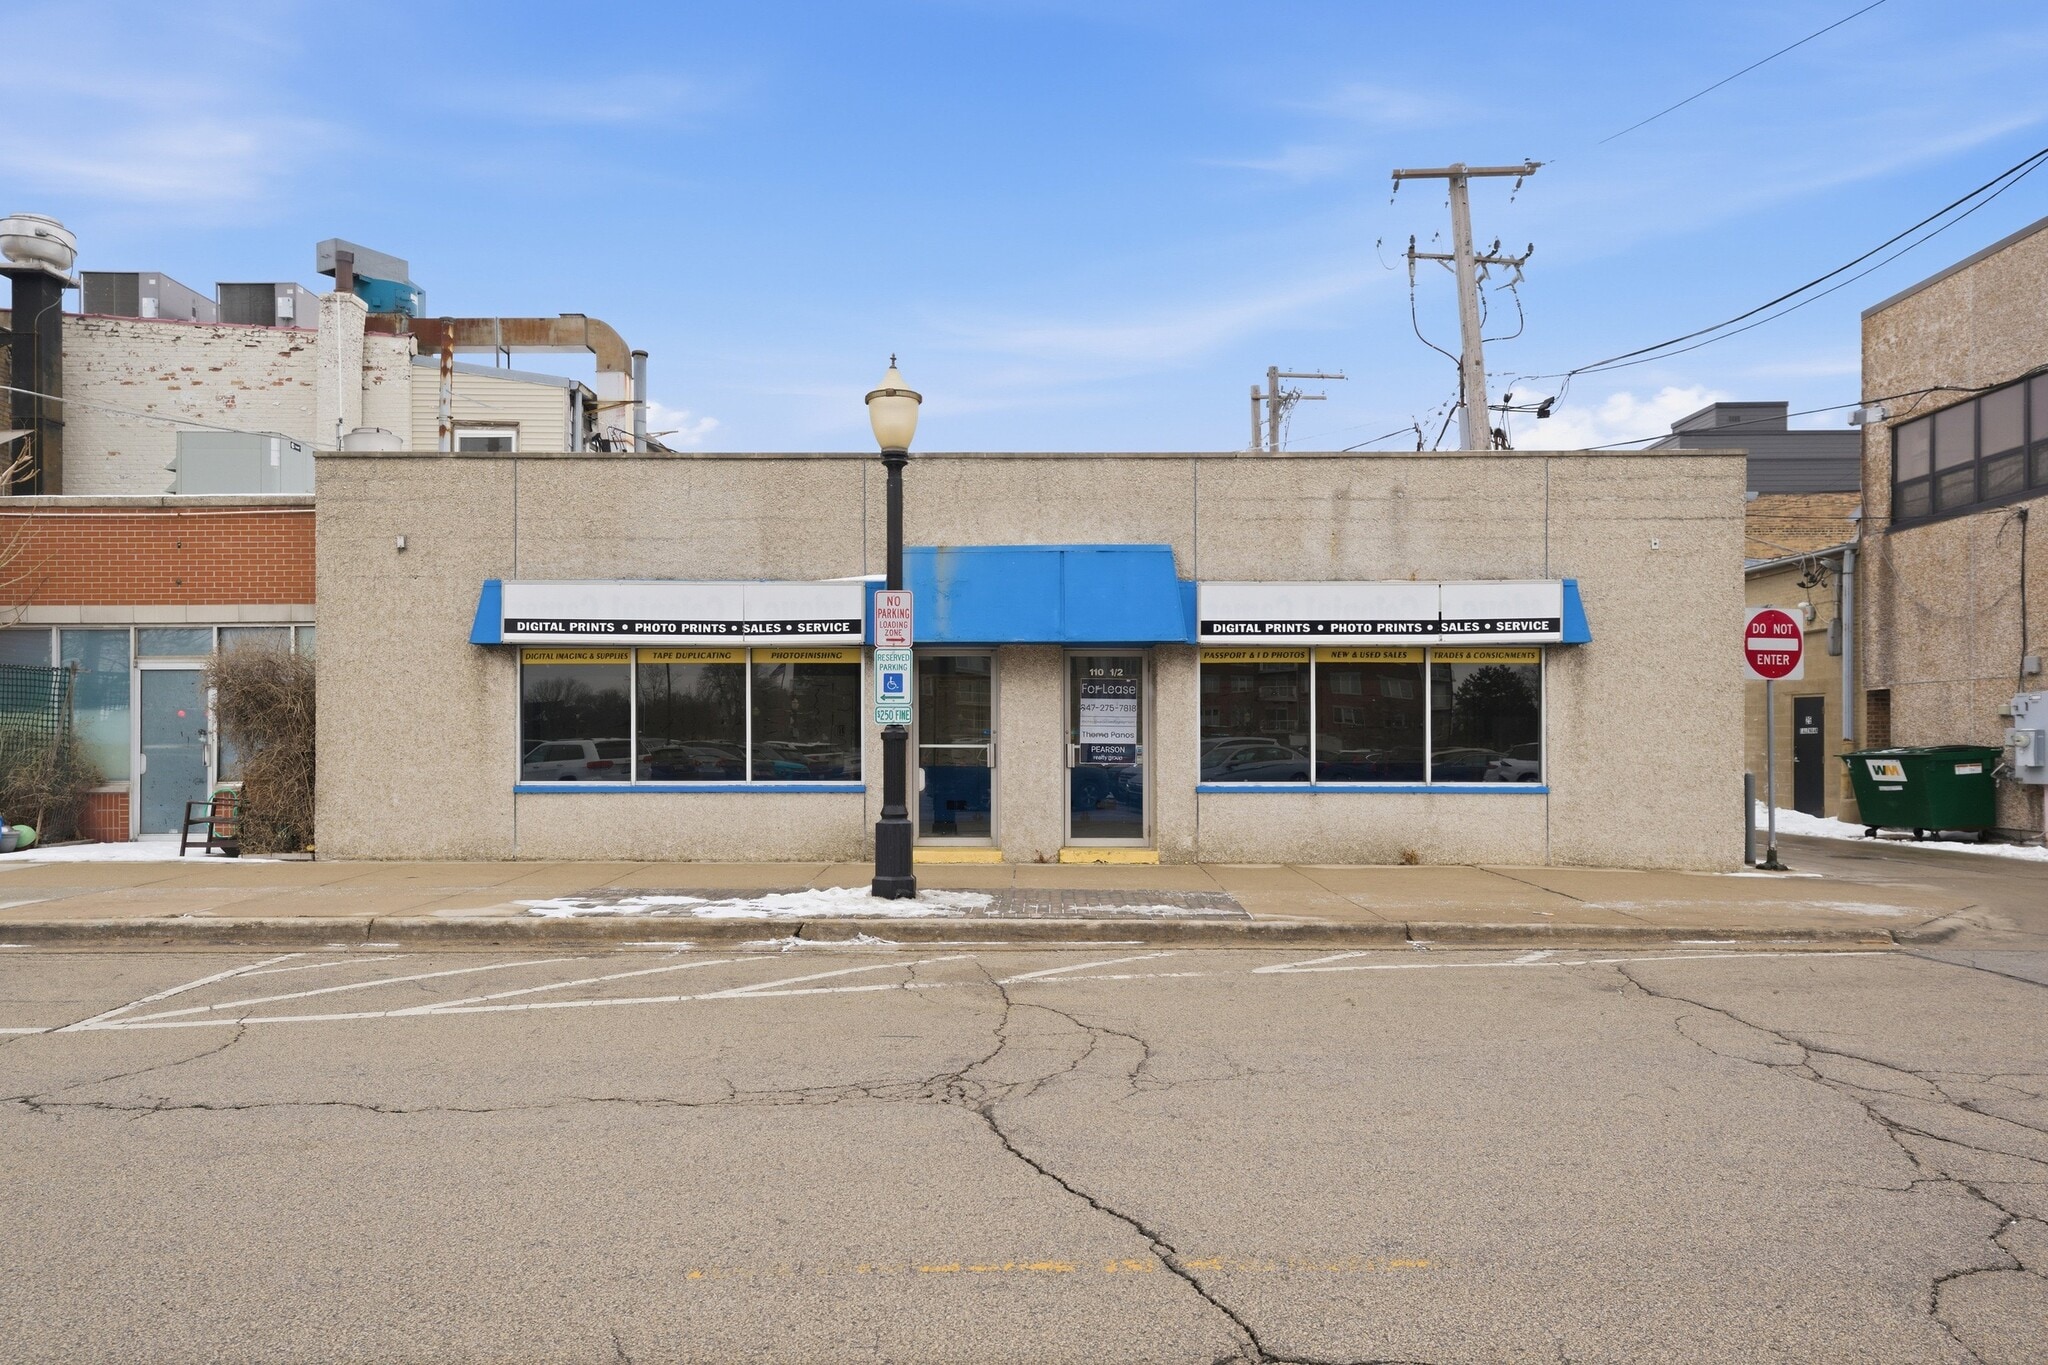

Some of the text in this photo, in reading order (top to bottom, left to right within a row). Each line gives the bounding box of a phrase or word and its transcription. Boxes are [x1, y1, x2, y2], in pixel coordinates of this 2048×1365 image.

[886, 596, 901, 607] NO
[877, 608, 910, 619] PARKING
[517, 621, 850, 634] DIGITAL PRINTS PHOTO PRINTS SALES SERVICE
[879, 621, 908, 629] LOADING
[1213, 621, 1549, 633] DIGITAL PRINTS PHOTO PRINTS SALES SERVICE
[1752, 623, 1793, 635] DO NOT
[884, 629, 902, 637] ZONE
[525, 652, 628, 660] DIGITAL IMAGING & SUPPLIES
[675, 652, 732, 660] DUPLICATING
[771, 652, 843, 660] PHOTOFINISHING
[877, 653, 910, 662] RESERVED
[1360, 651, 1381, 659] USED
[1434, 651, 1536, 659] TRADES & CONSIGNMENTS
[1757, 654, 1790, 666] ENTER
[1089, 668, 1123, 677] 110 1/2
[1102, 683, 1136, 695] Lease
[877, 710, 910, 720] $250 FINE
[1872, 764, 1900, 776] WM
